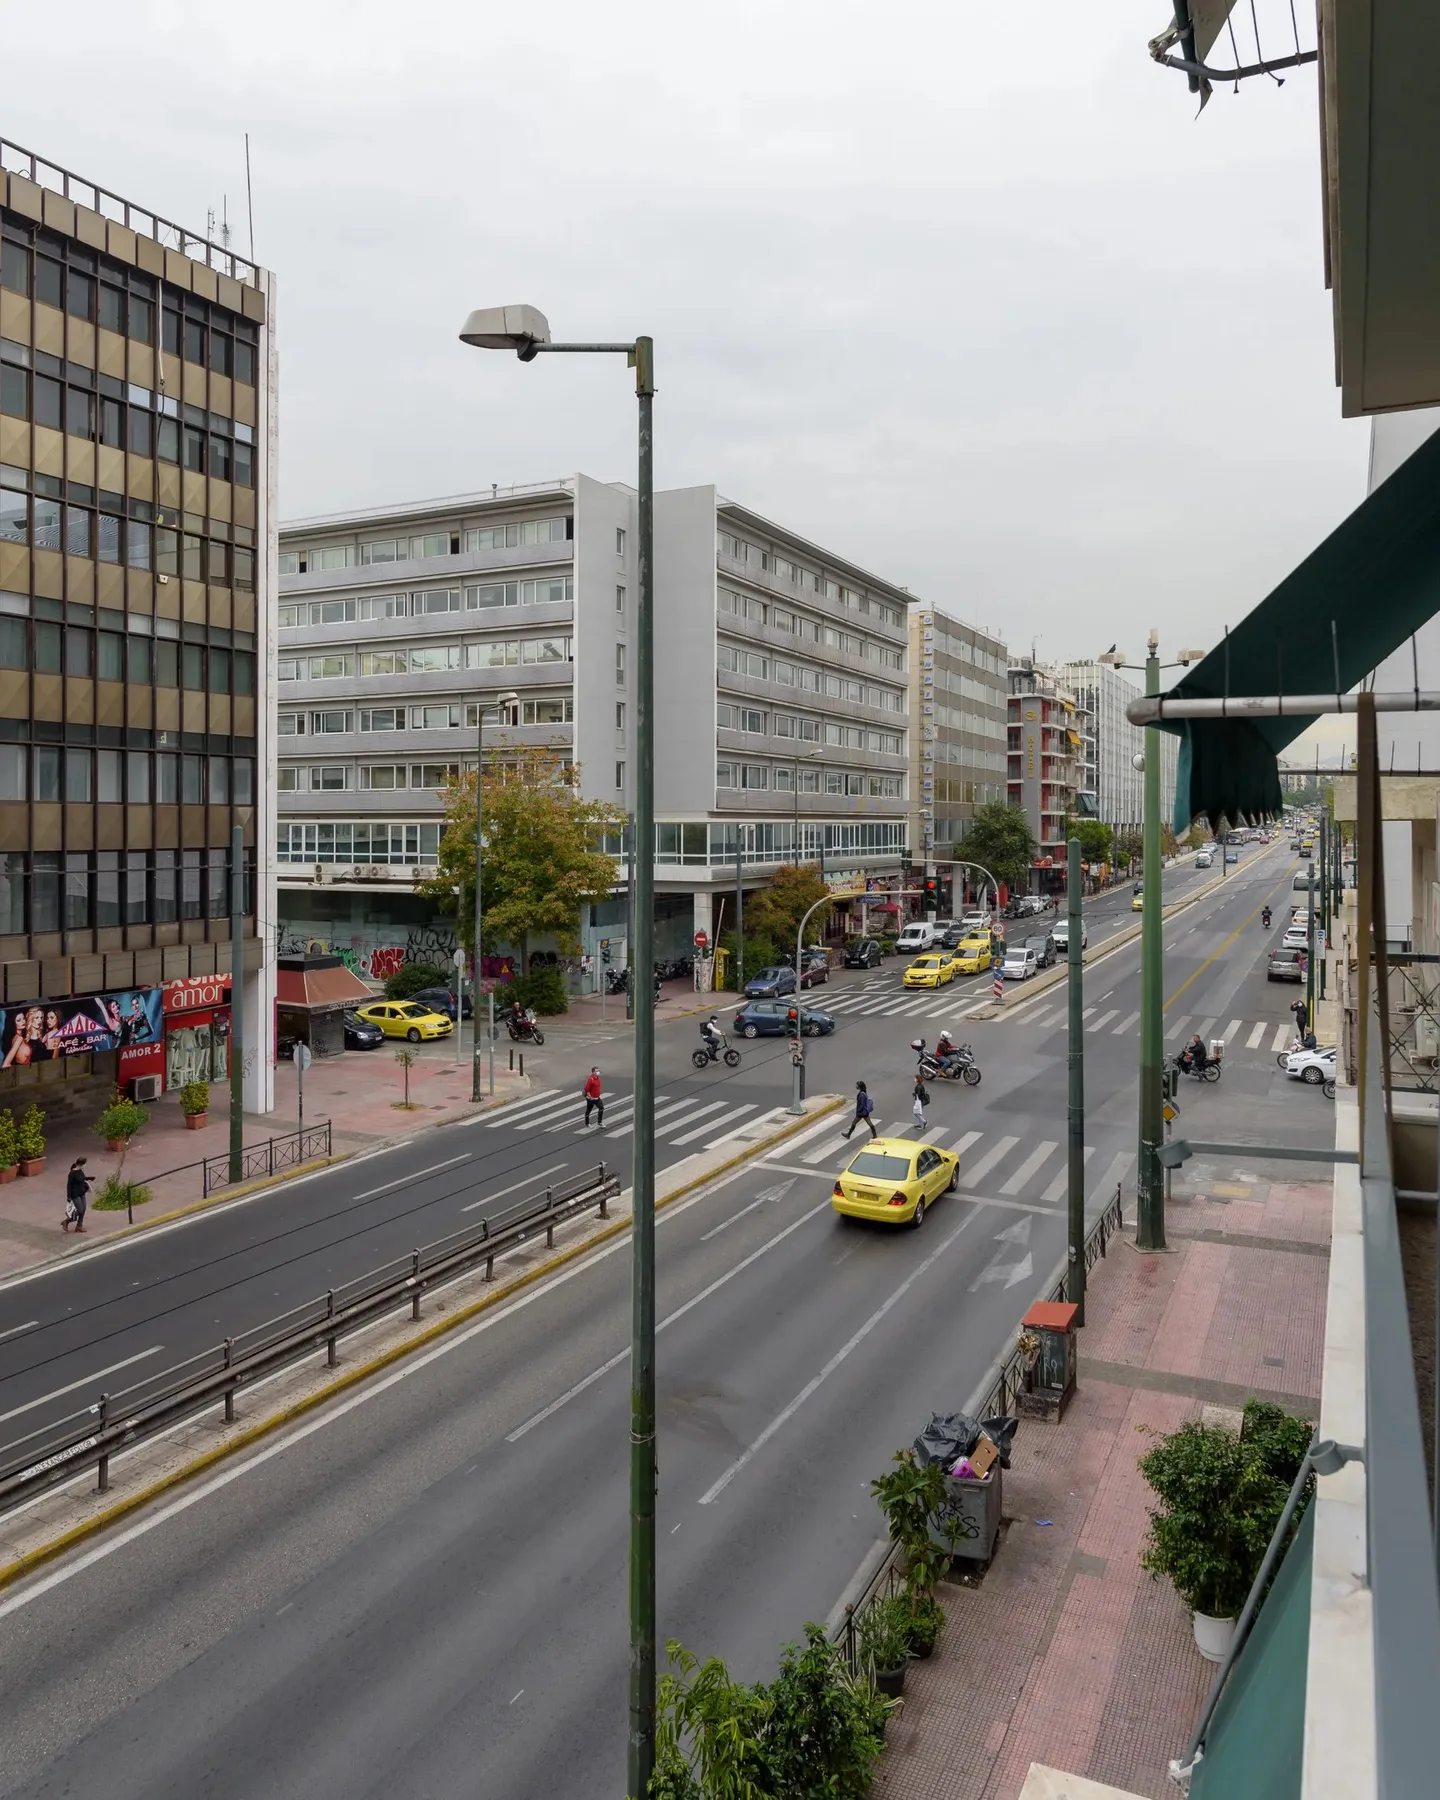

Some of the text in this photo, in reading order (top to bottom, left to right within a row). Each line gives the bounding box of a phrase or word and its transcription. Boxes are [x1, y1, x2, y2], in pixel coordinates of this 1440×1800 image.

[171, 983, 225, 1009] amor
[86, 1034, 107, 1044] BAR
[121, 1043, 161, 1060] AMOR 2
